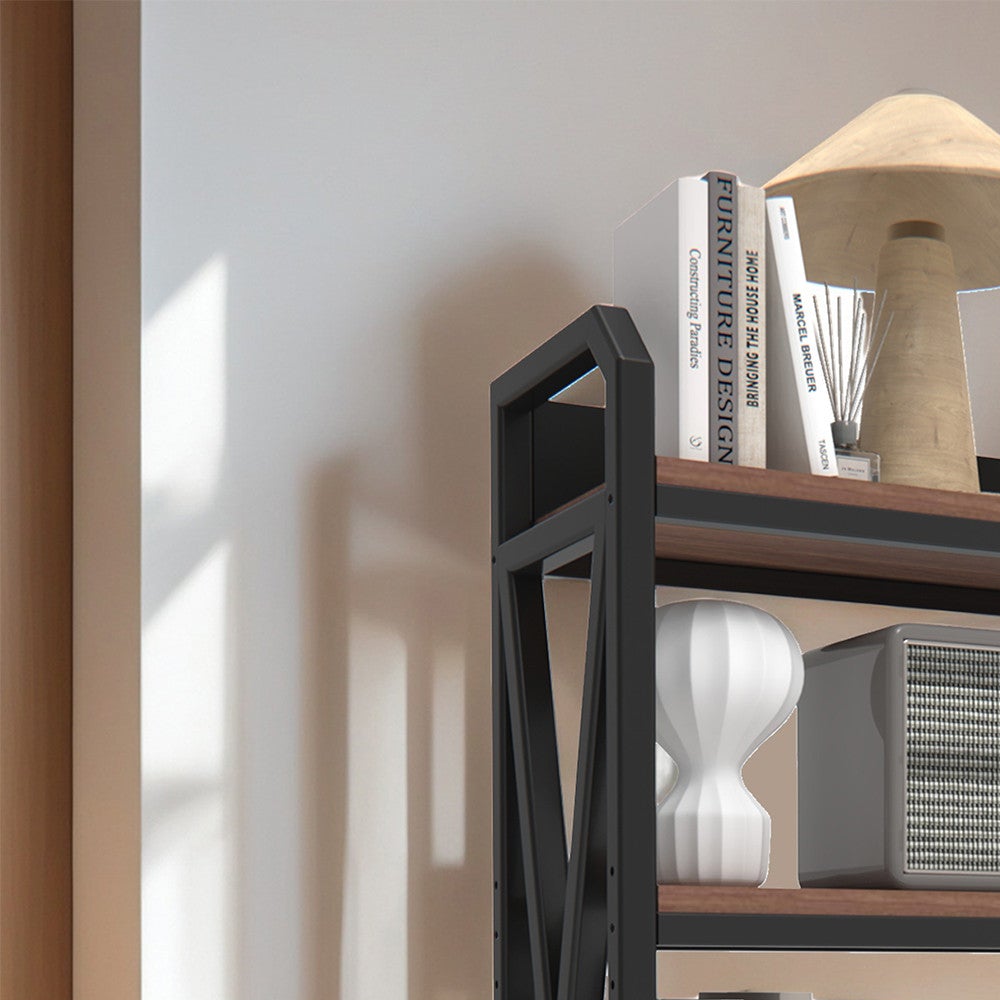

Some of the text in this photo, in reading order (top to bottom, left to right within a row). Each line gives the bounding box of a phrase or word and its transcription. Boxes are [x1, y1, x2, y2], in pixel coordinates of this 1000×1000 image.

[687, 248, 702, 369] Constructing Paradies
[717, 177, 734, 465] FURNITURE DESIGN
[746, 250, 760, 408] BRINGING THE HOUSE HOME
[792, 293, 817, 393] MARCEL BREUER
